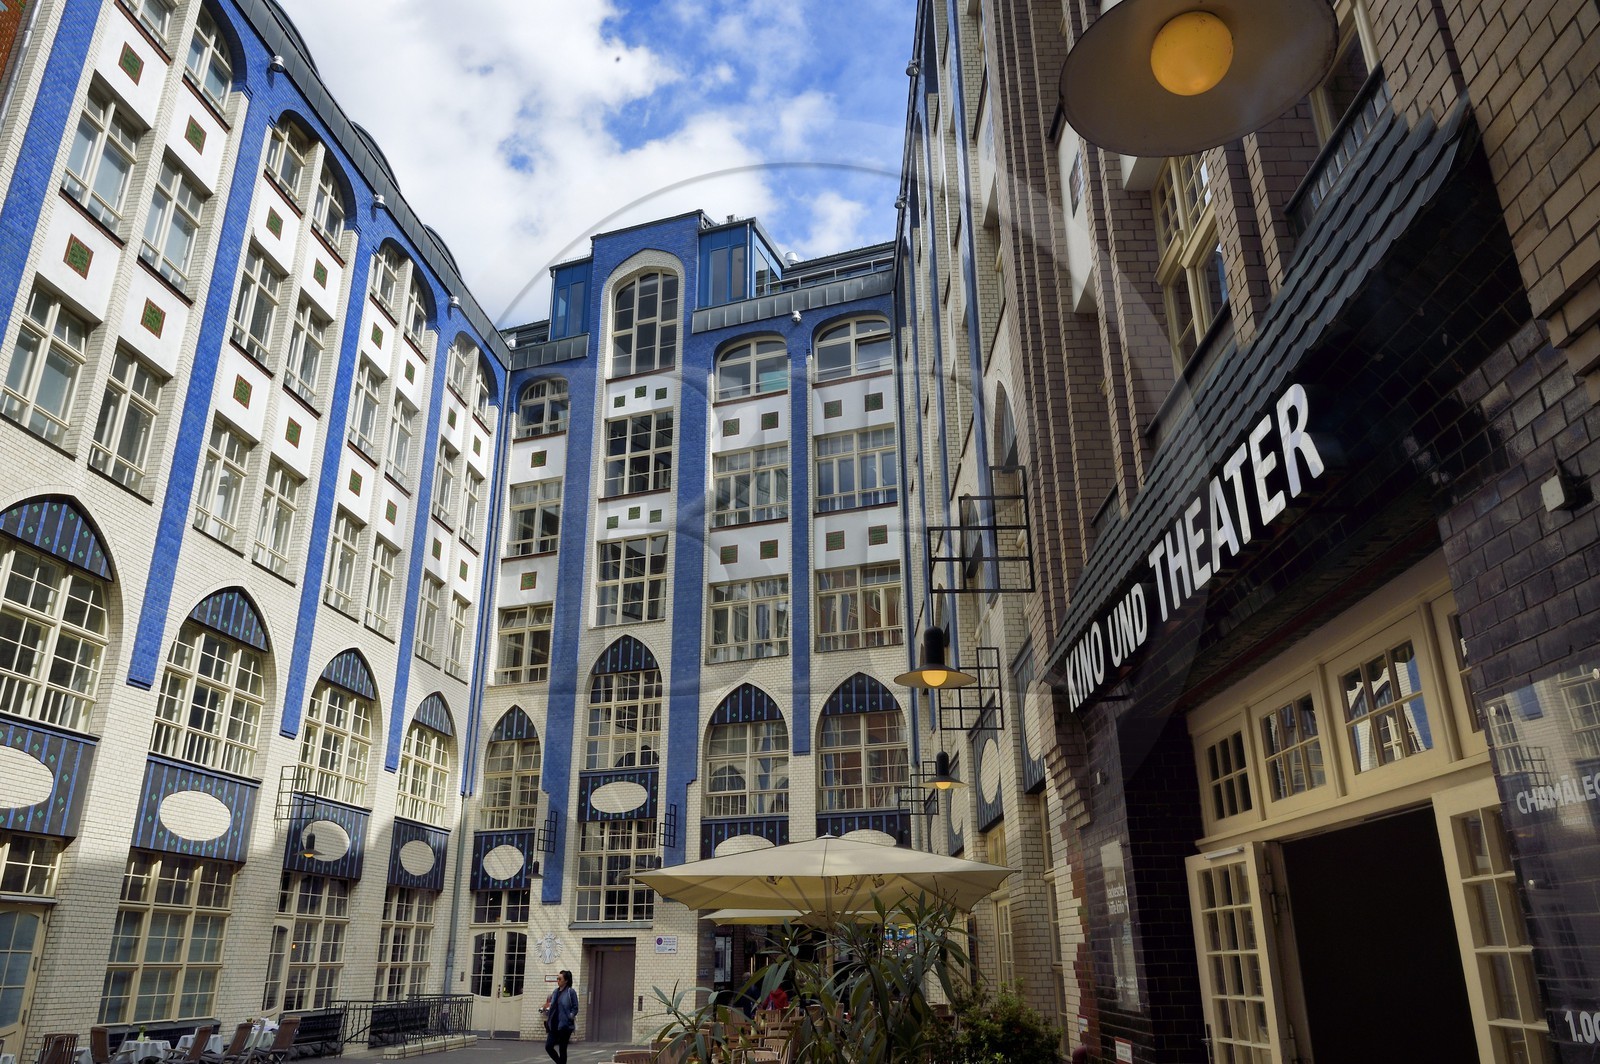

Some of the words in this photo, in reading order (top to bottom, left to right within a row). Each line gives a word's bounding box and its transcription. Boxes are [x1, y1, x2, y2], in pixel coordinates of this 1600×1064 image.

[1066, 621, 1105, 712] KINO
[1107, 582, 1148, 667] UND
[1148, 383, 1325, 622] THEATER
